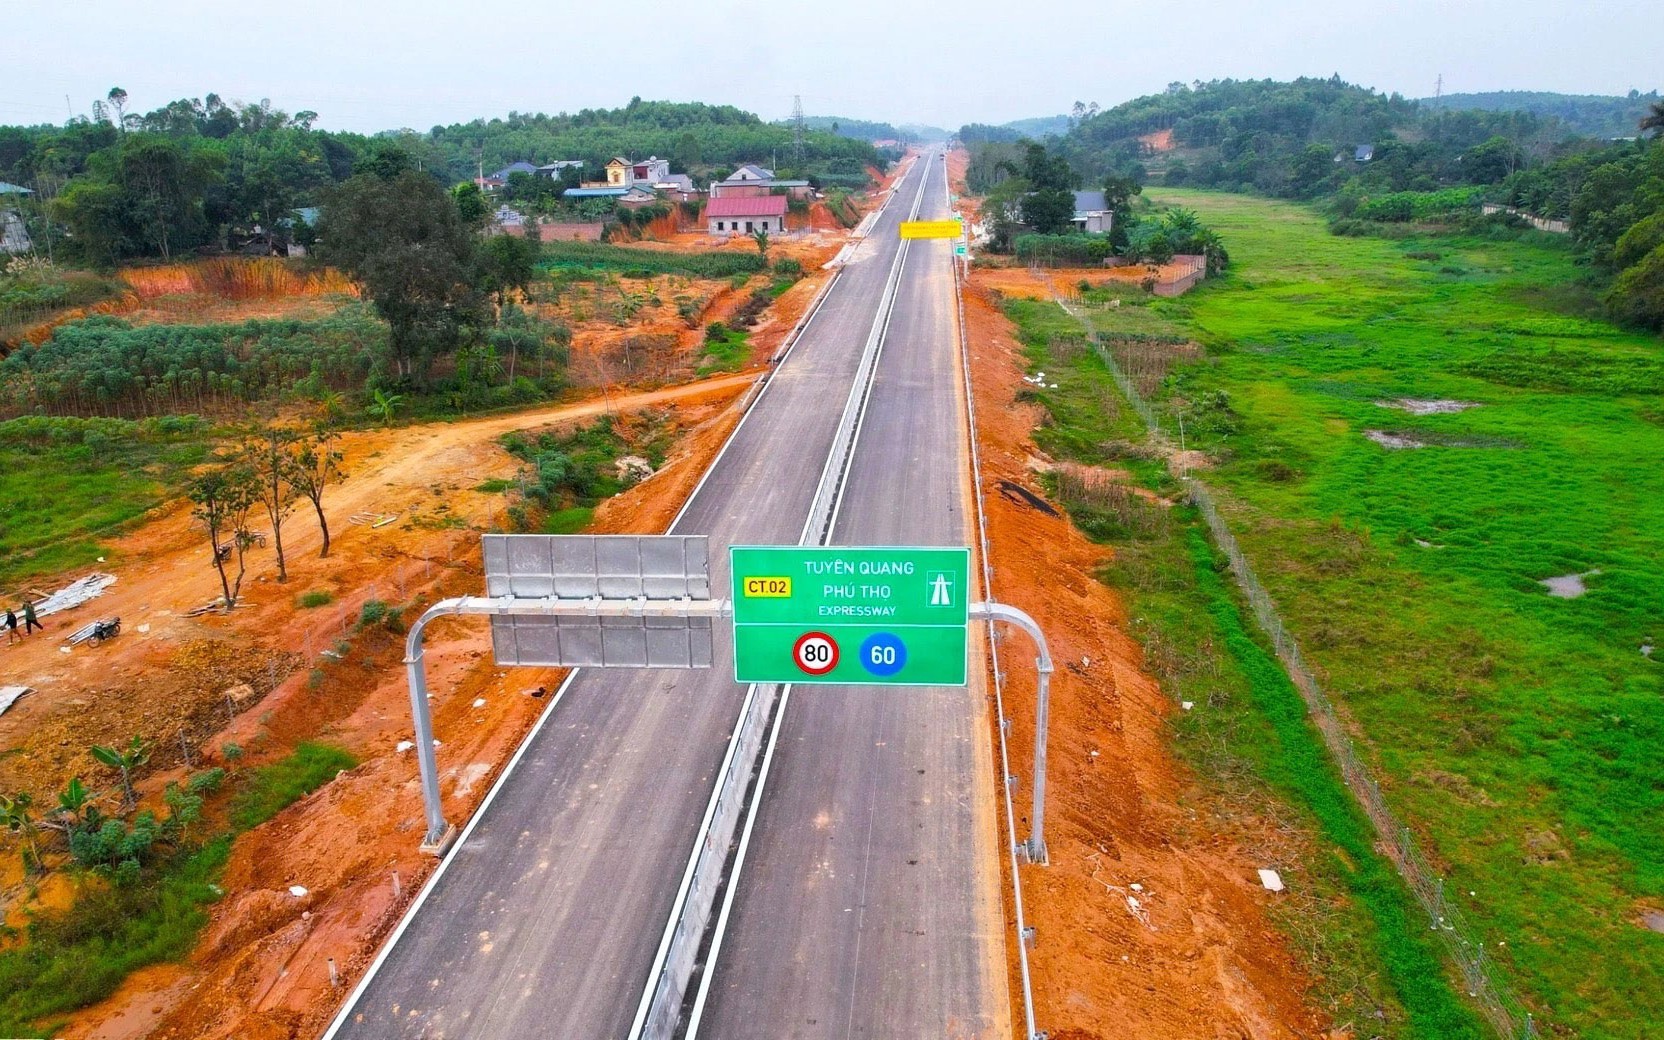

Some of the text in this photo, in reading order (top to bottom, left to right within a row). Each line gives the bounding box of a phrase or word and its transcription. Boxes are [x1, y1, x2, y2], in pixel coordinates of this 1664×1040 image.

[804, 559, 914, 575] TUYÊN QUANG
[748, 580, 786, 593] CT.02
[823, 582, 891, 601] PHÚ THỌ
[818, 605, 896, 616] EXPRESSWAY
[804, 644, 829, 662] 80
[871, 646, 896, 665] 60
